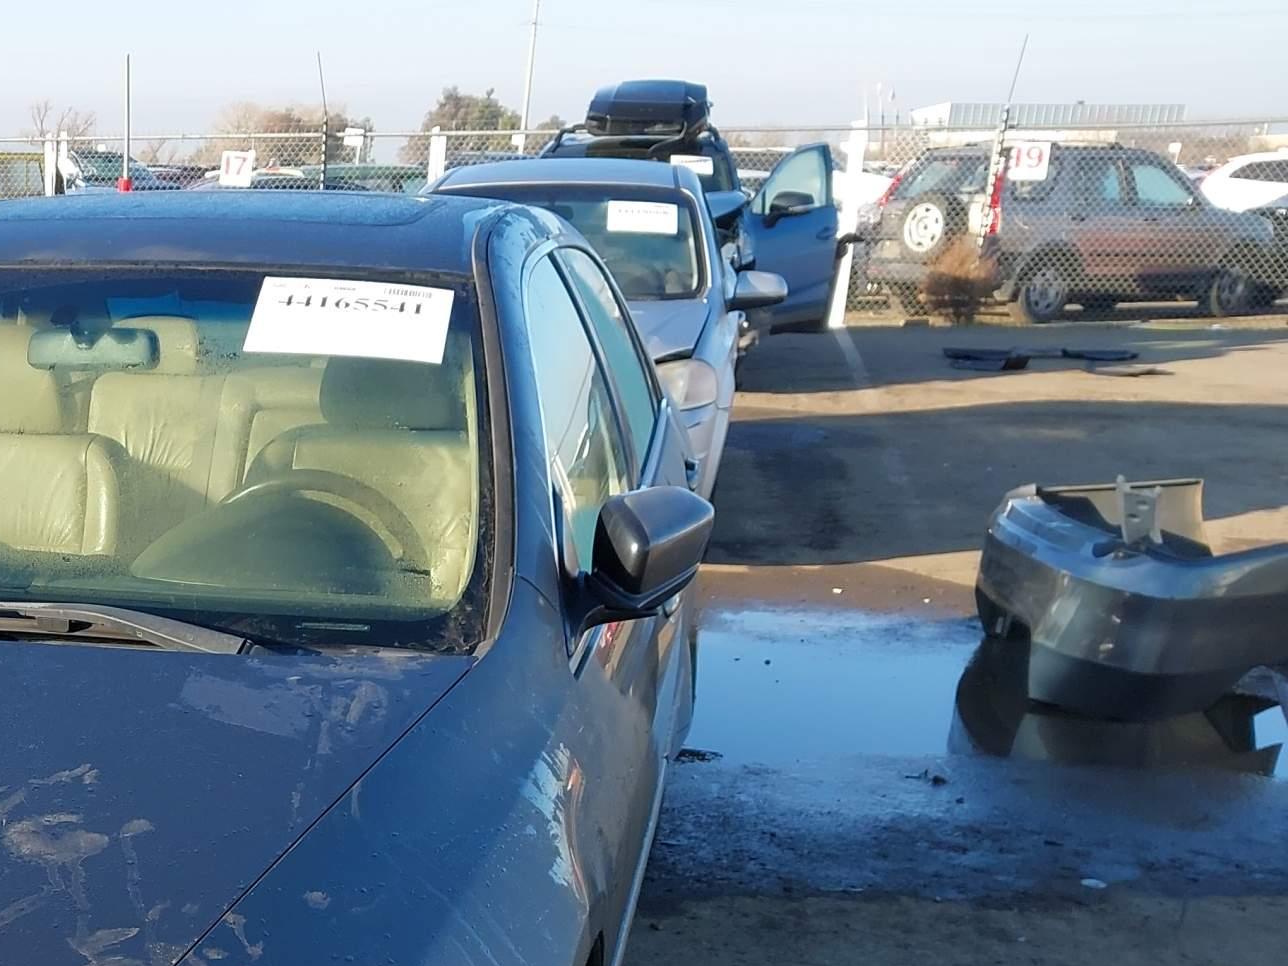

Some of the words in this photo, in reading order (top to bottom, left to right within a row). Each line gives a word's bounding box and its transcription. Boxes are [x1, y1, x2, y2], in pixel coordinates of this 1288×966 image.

[225, 155, 248, 175] 17
[1014, 146, 1043, 168] 19
[277, 293, 423, 316] 44165541
